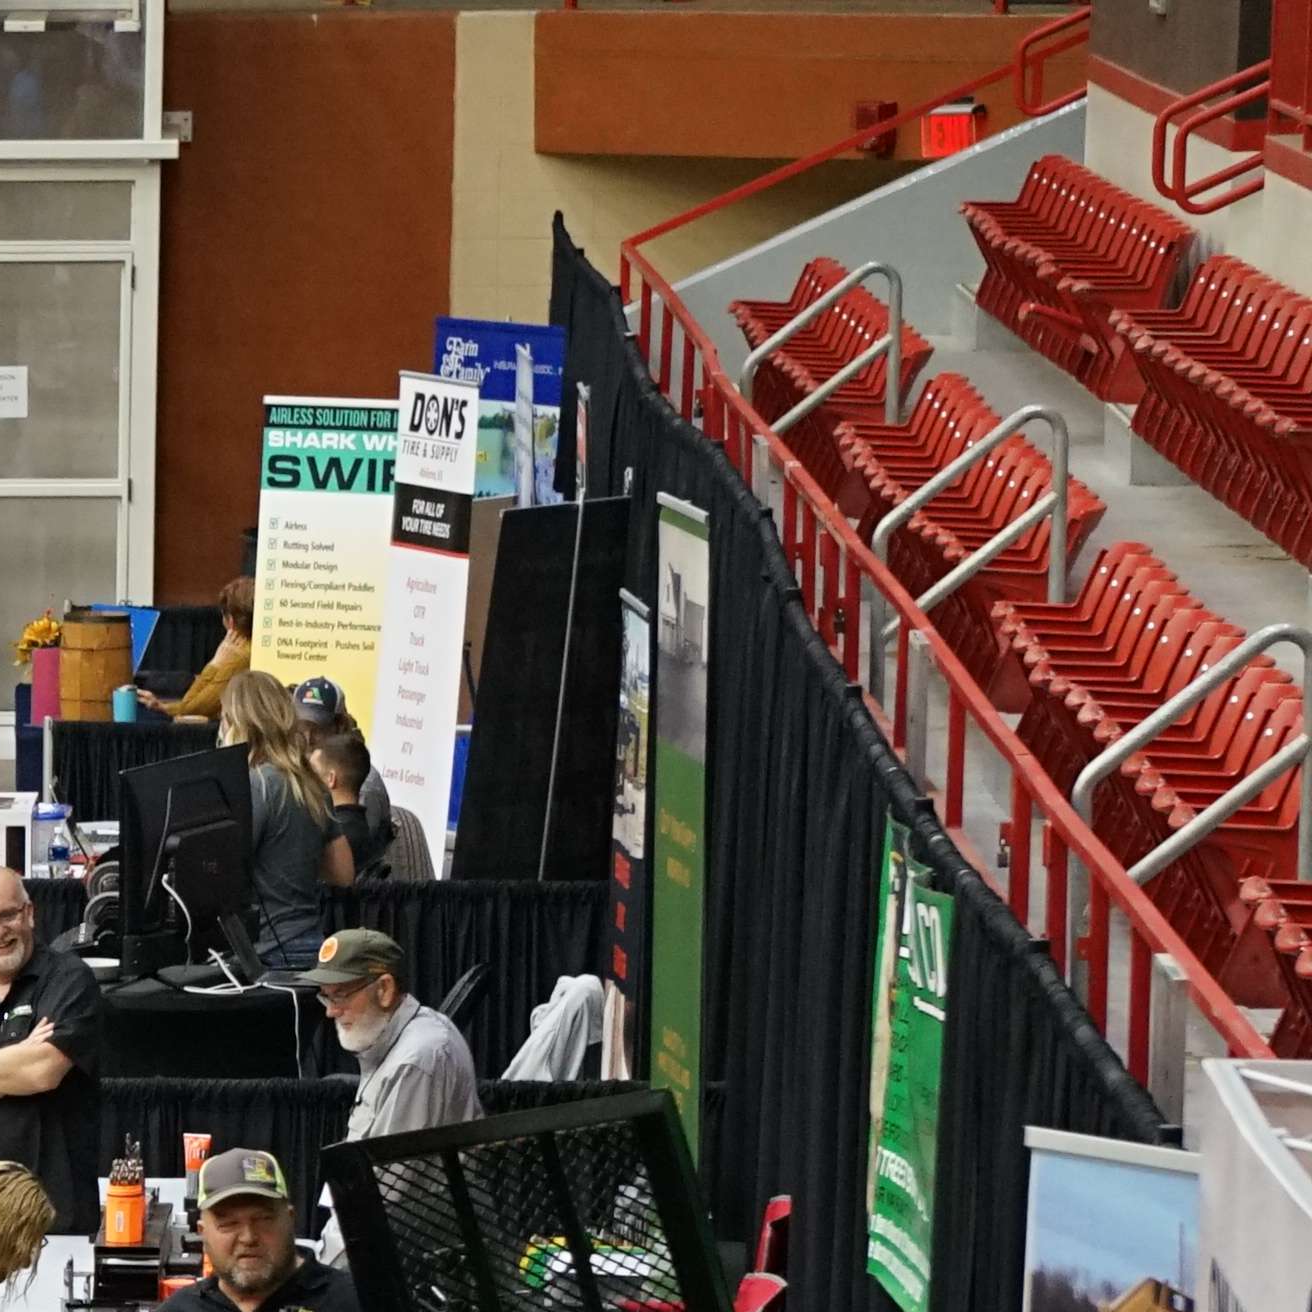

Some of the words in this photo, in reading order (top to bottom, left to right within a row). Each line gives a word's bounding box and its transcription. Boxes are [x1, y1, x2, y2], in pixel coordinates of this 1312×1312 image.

[446, 336, 479, 356] Farm
[453, 356, 487, 385] Family
[269, 407, 314, 427] AIRLESS
[316, 408, 369, 428] SOLUTION
[370, 410, 391, 429] FOR
[409, 391, 468, 441] DON'S
[268, 430, 357, 450] SHARK
[401, 438, 422, 457] TIRE
[430, 443, 460, 464] SUPPLY
[412, 498, 428, 515] FOR
[427, 501, 437, 516] ALL
[436, 503, 445, 518] OF
[284, 520, 308, 531] Airless
[401, 516, 419, 533] YOUR
[419, 519, 433, 536] TIRE
[433, 521, 451, 539] NEEDS
[283, 540, 309, 552] Rutting
[311, 542, 335, 552] Solved
[282, 559, 311, 570] Modular
[313, 561, 338, 574] Design
[347, 583, 376, 593] Paddles
[290, 599, 315, 609] Second
[317, 600, 334, 610] Field
[336, 601, 363, 613] Repairs
[278, 618, 336, 632] Best-in-Industry
[337, 621, 382, 632] Performance
[276, 637, 293, 647] DNA
[295, 638, 328, 651] Footprint
[335, 640, 360, 651] Pushes
[362, 641, 375, 651] Soil
[277, 651, 302, 661] Toward
[304, 652, 328, 662] Center
